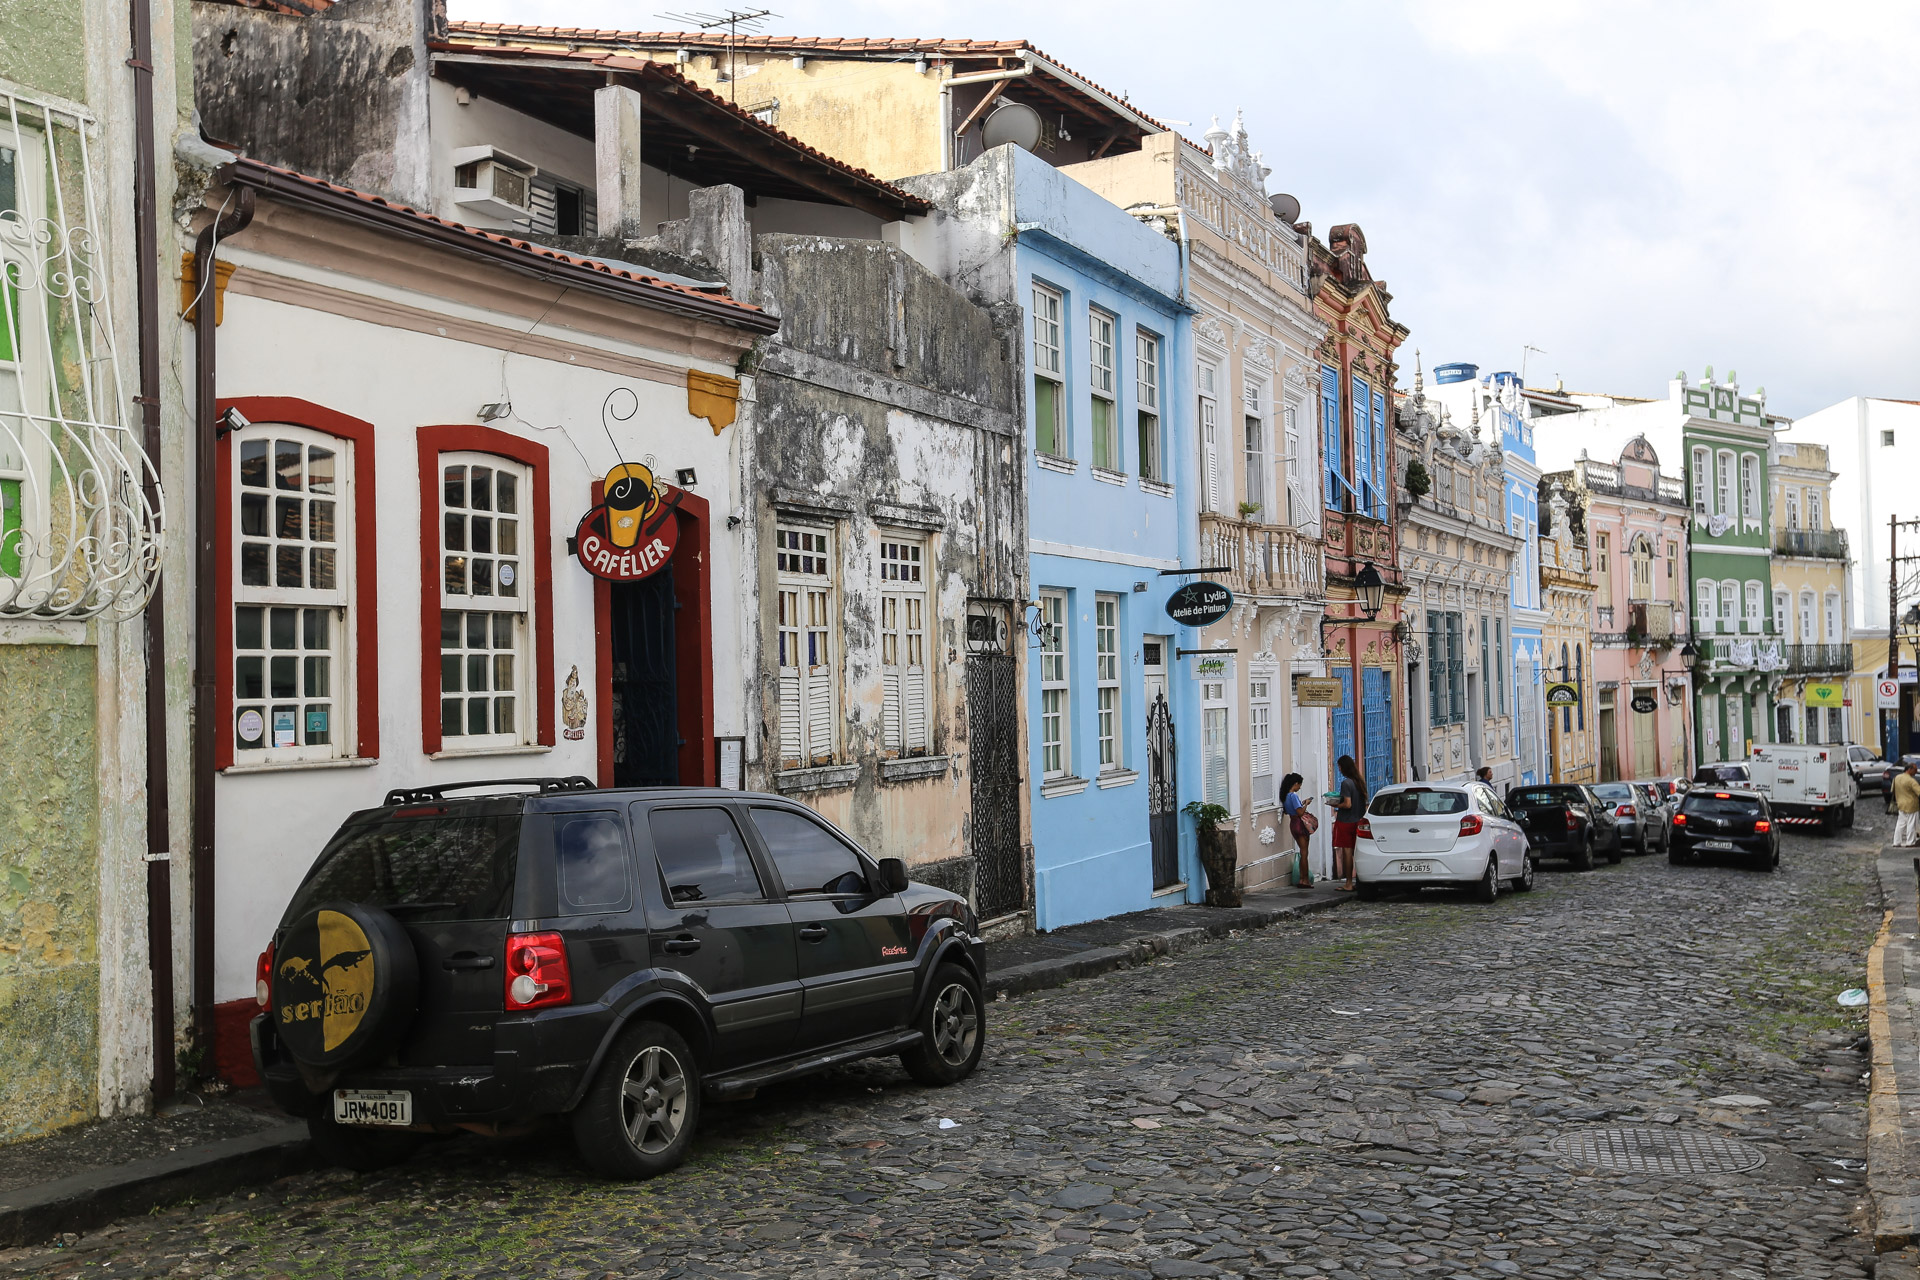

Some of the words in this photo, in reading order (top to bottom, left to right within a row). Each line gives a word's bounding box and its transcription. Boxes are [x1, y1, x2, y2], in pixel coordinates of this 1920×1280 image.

[582, 536, 670, 576] CAFÉLIER
[1204, 590, 1227, 603] Lydia
[1173, 606, 1193, 618] Ateliê
[1193, 605, 1203, 615] de
[1203, 603, 1227, 614] Pintura
[1778, 758, 1799, 766] GELO
[281, 988, 365, 1024] sertão
